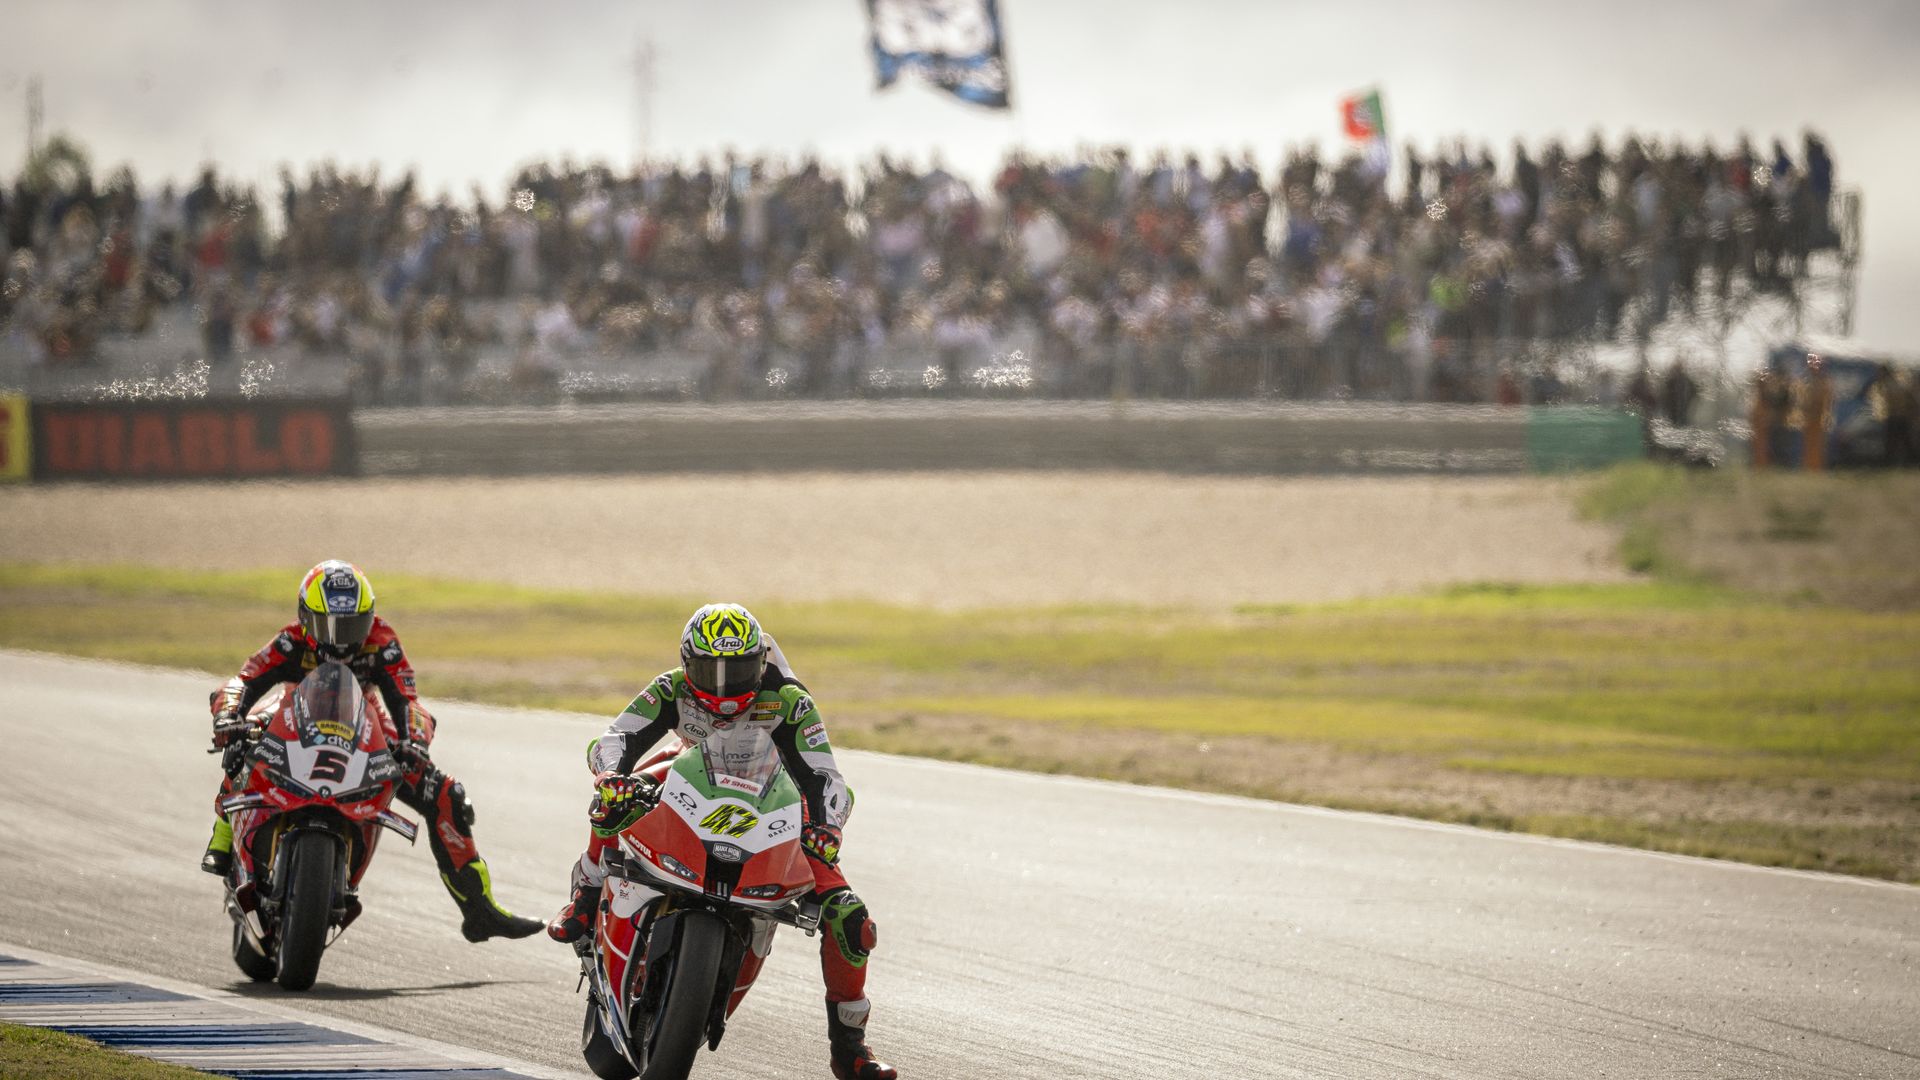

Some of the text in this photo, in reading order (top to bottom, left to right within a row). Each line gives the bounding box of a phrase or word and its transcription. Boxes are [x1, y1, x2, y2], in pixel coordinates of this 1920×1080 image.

[46, 410, 335, 473] DIABLO
[714, 638, 741, 649] Arai
[327, 735, 351, 751] dto
[309, 750, 350, 784] 5
[669, 791, 696, 817] OAKLEY
[699, 803, 759, 838] 47
[768, 824, 796, 838] OAKLEY
[629, 834, 653, 859] MOTUL
